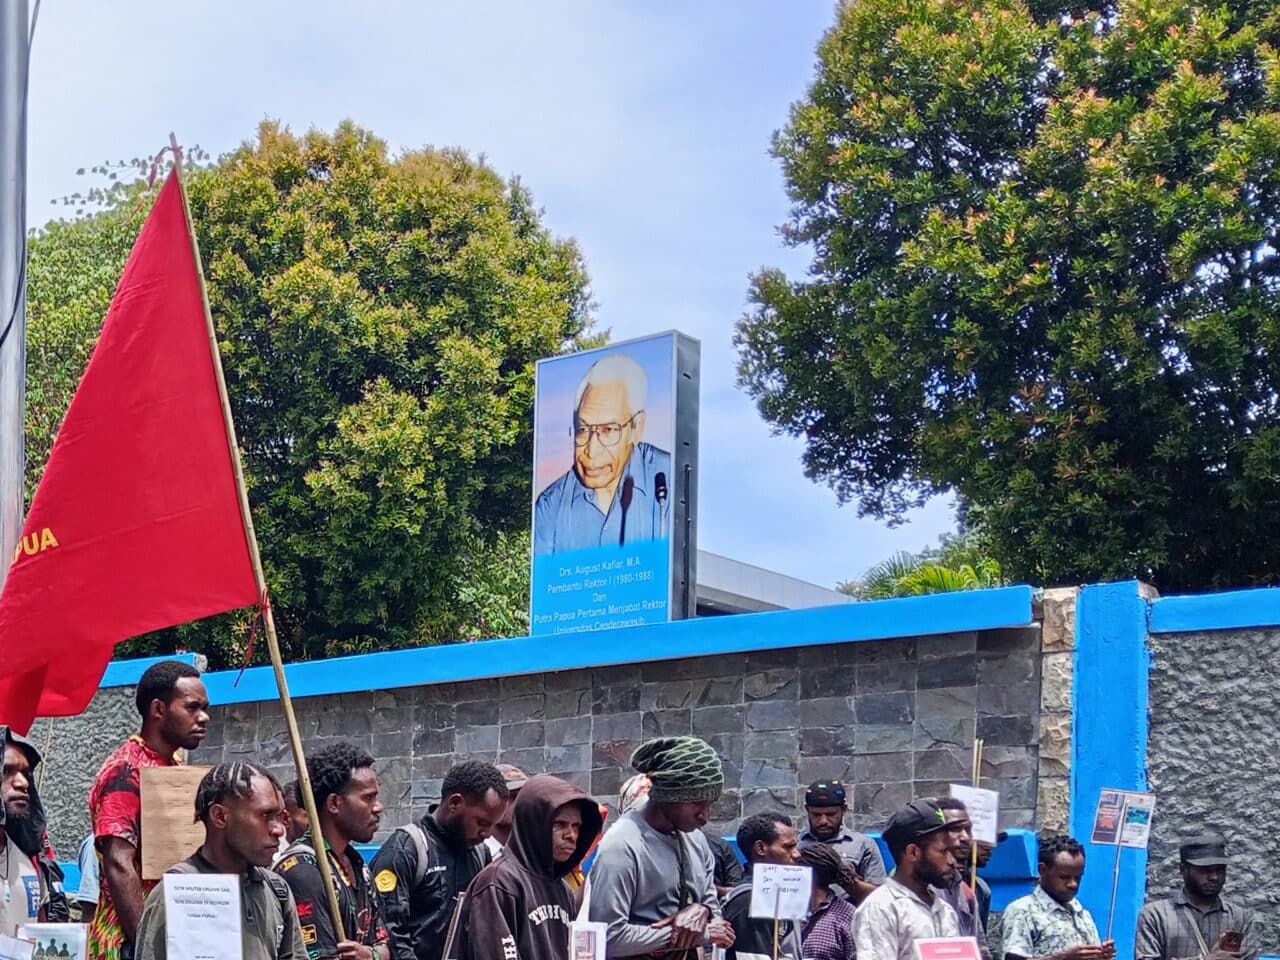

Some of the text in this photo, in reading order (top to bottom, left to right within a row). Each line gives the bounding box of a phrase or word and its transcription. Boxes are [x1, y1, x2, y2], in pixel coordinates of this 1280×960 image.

[575, 563, 601, 575] August
[547, 579, 582, 593] Pembantu
[584, 576, 607, 589] Rektor
[592, 593, 607, 603] Dan
[554, 612, 576, 623] Papua
[577, 608, 607, 618] Pertama
[608, 603, 640, 616] Menjabat
[642, 599, 666, 611] Rektor
